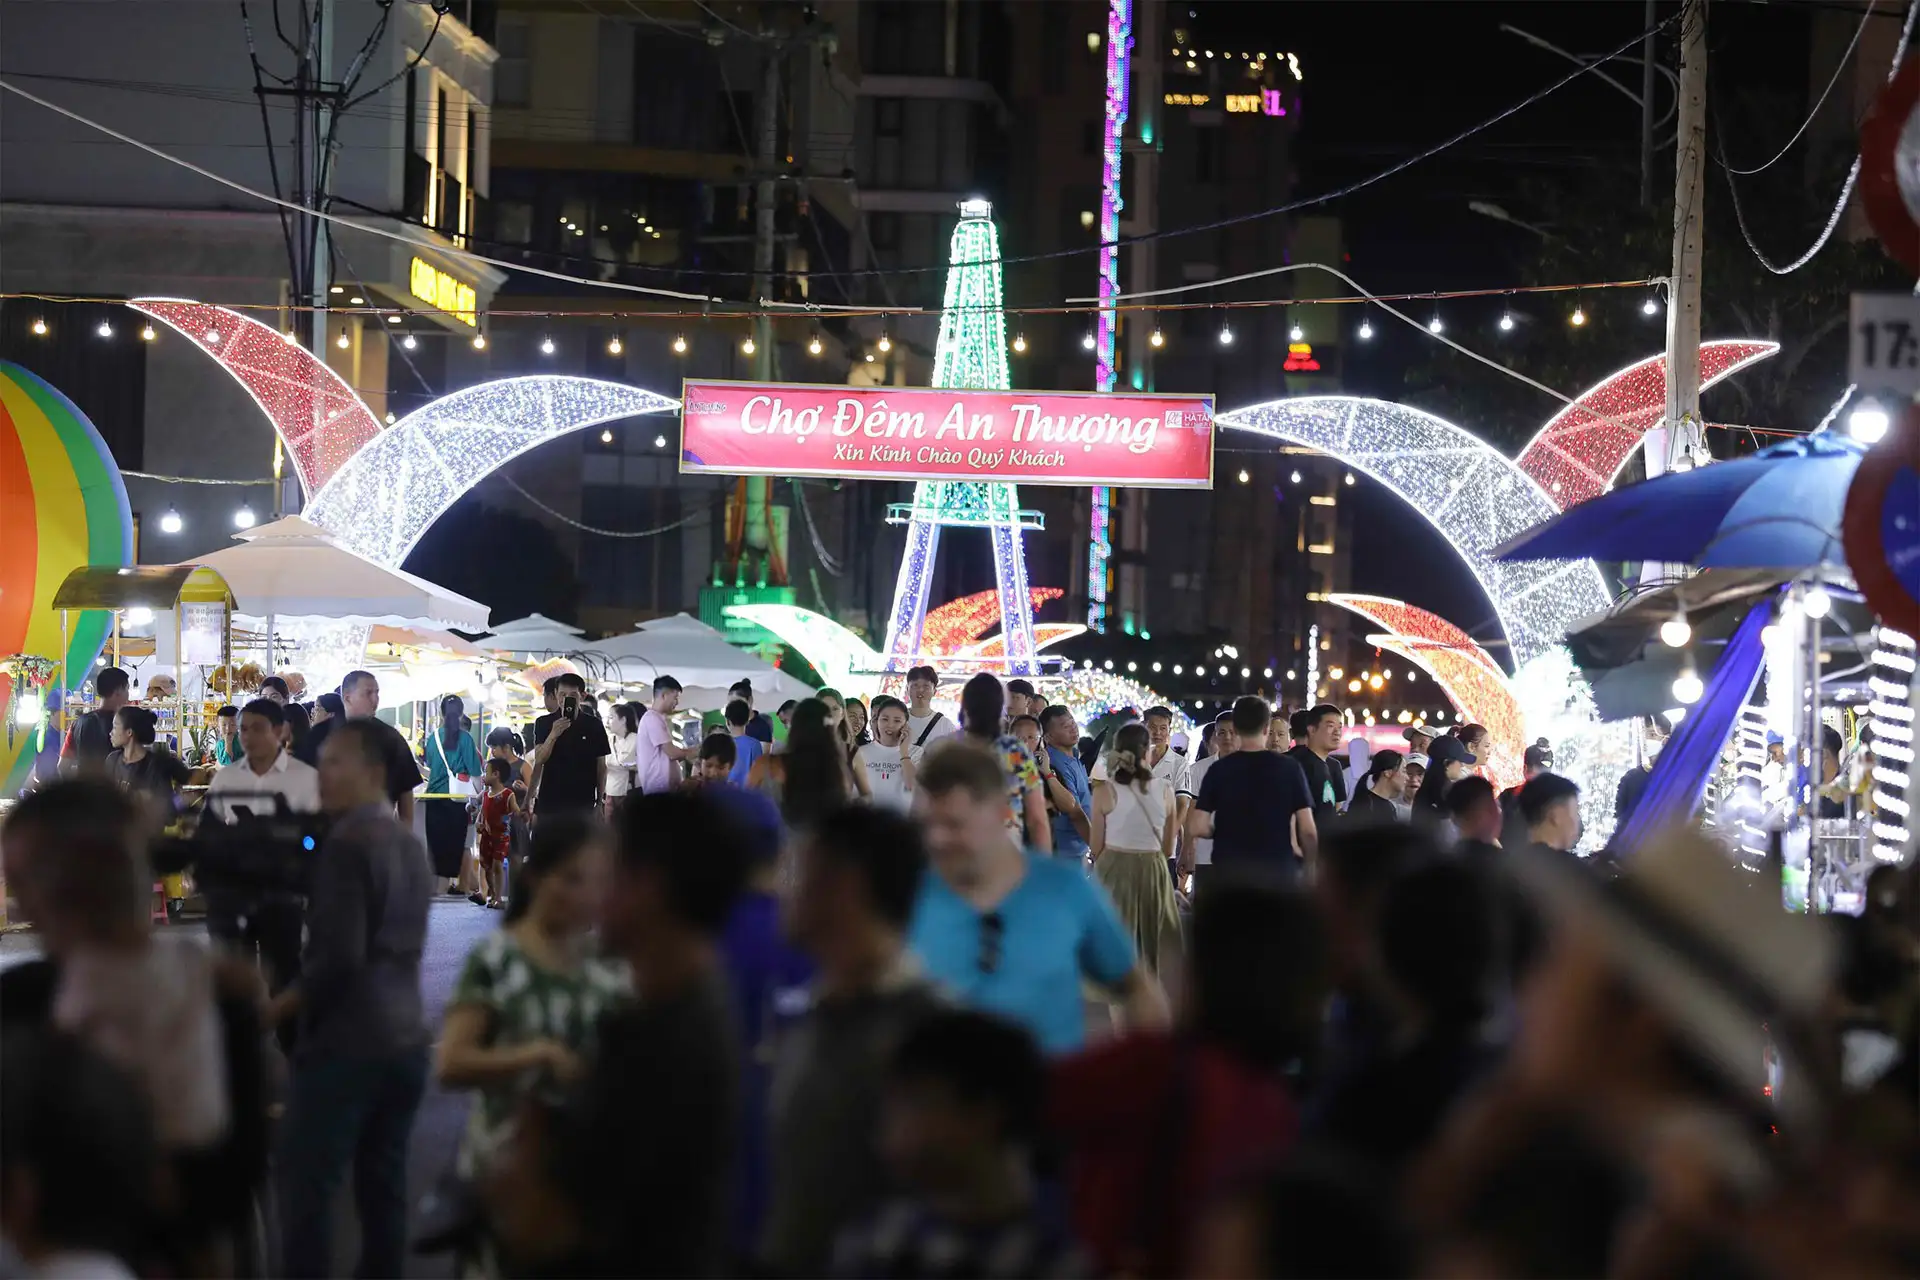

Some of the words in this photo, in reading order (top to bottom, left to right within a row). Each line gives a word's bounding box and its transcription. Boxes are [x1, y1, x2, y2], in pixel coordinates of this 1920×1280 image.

[740, 395, 824, 444] Chợ
[831, 399, 928, 439] Đêm
[935, 402, 996, 441] An
[1010, 403, 1160, 453] Thượng
[833, 443, 865, 461] Xin
[869, 445, 912, 463] Kính
[916, 446, 962, 464] Chào
[967, 447, 1004, 468] Quý
[1008, 448, 1065, 467] Khách
